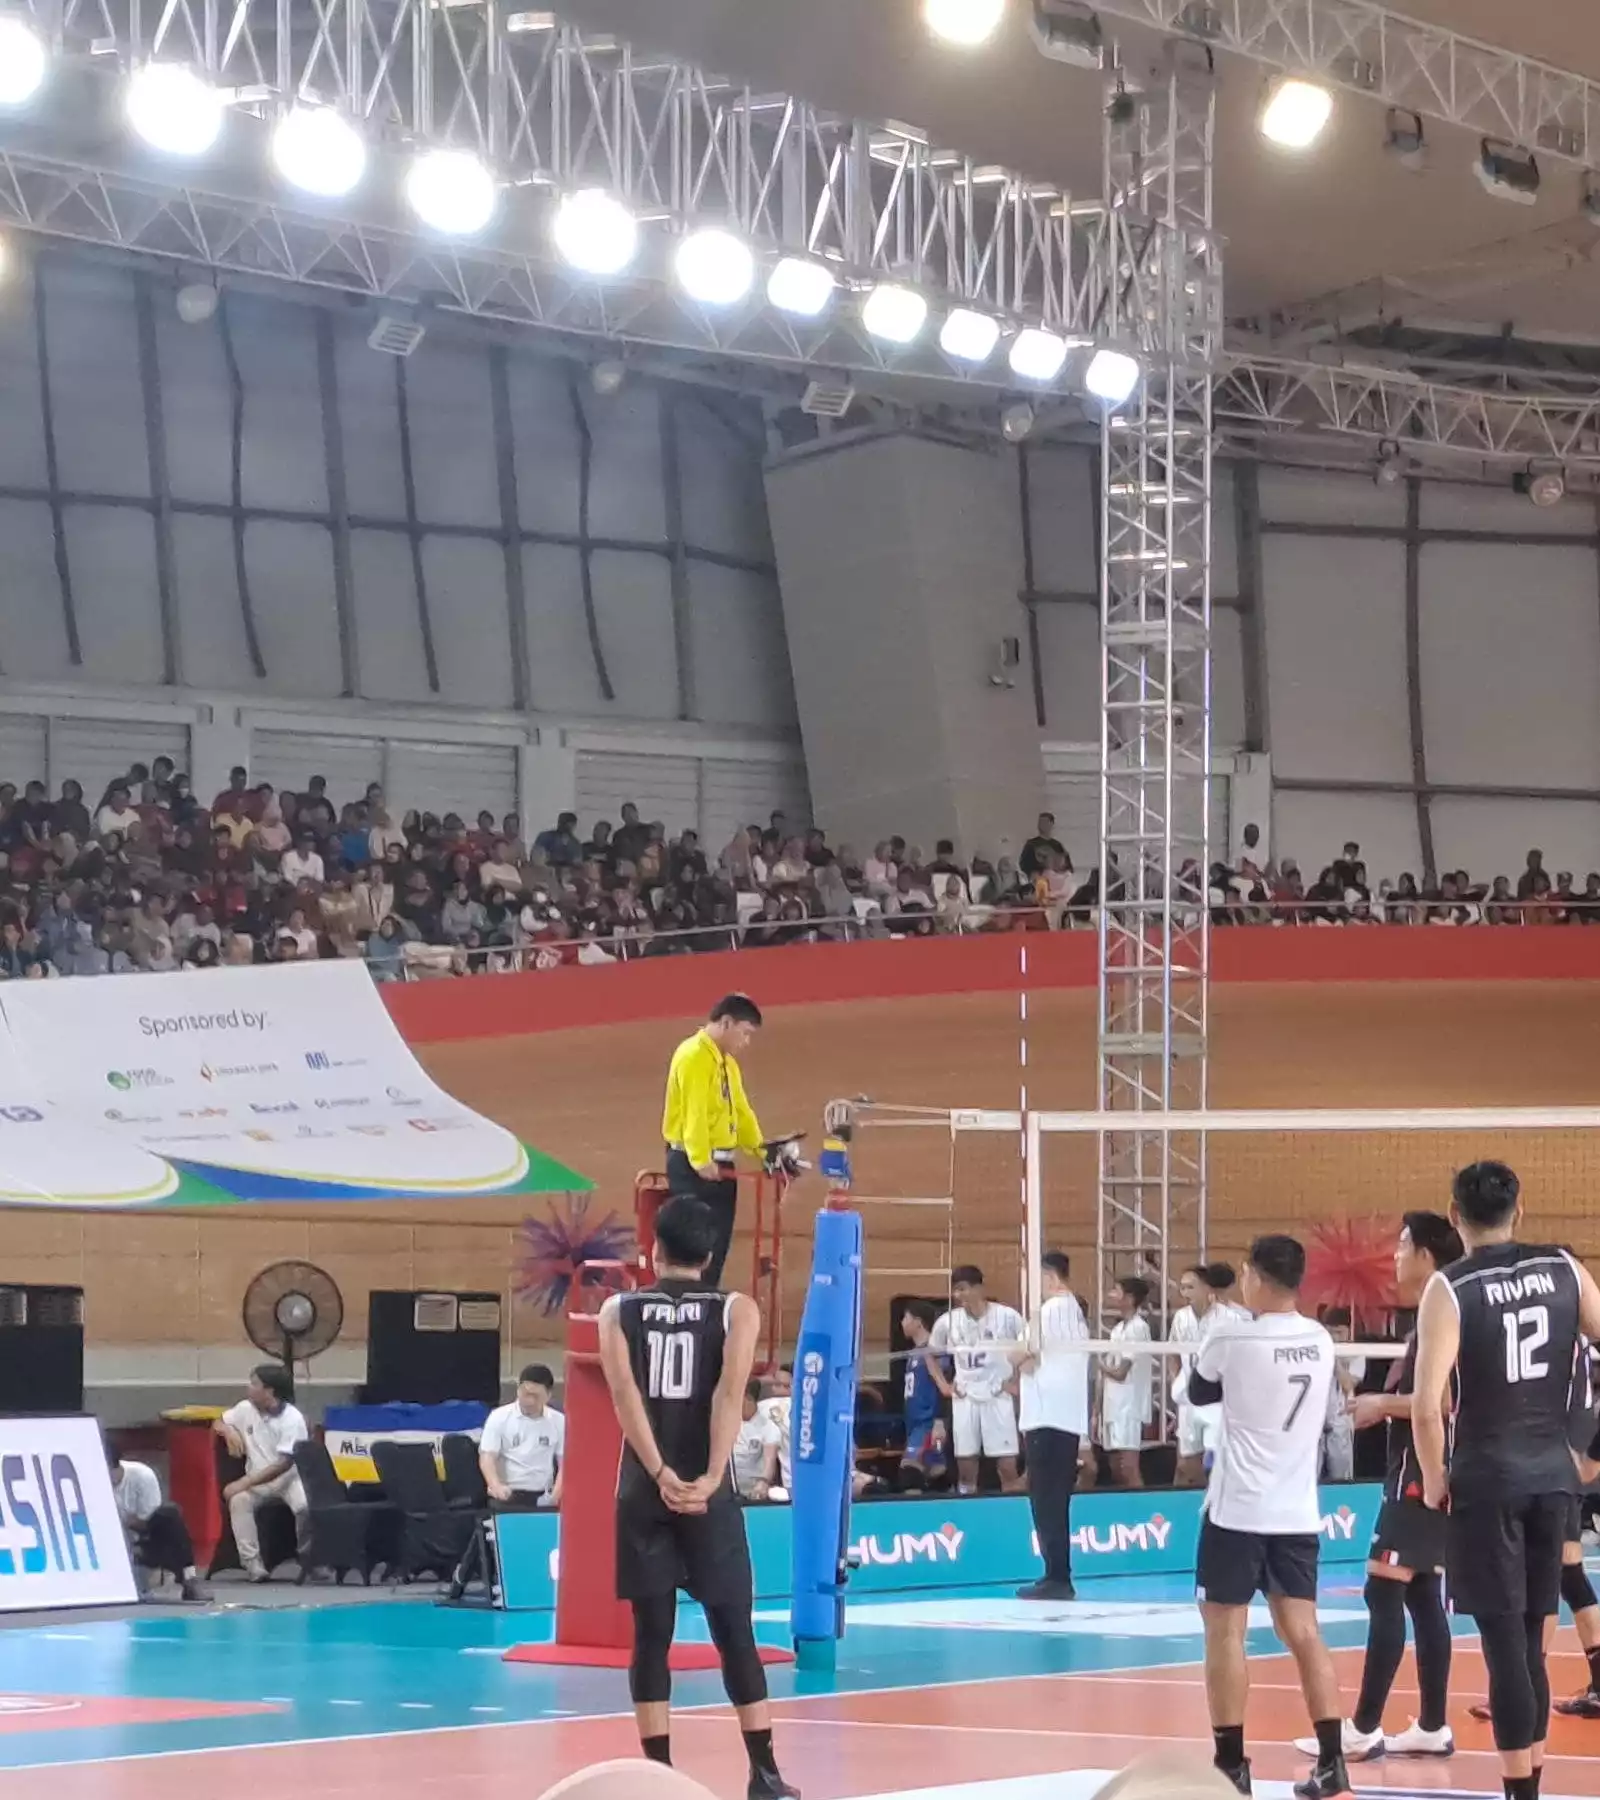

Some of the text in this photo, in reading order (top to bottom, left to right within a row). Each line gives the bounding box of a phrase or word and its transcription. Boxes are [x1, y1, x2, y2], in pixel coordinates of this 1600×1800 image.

[139, 1008, 239, 1038] Sponsored
[1485, 1272, 1555, 1306] RIVAN
[1502, 1305, 1549, 1383] 12
[647, 1330, 694, 1399] 10
[1282, 1374, 1312, 1432] 7
[847, 1530, 964, 1564] HUMY
[1031, 1521, 1172, 1557] HUMY
